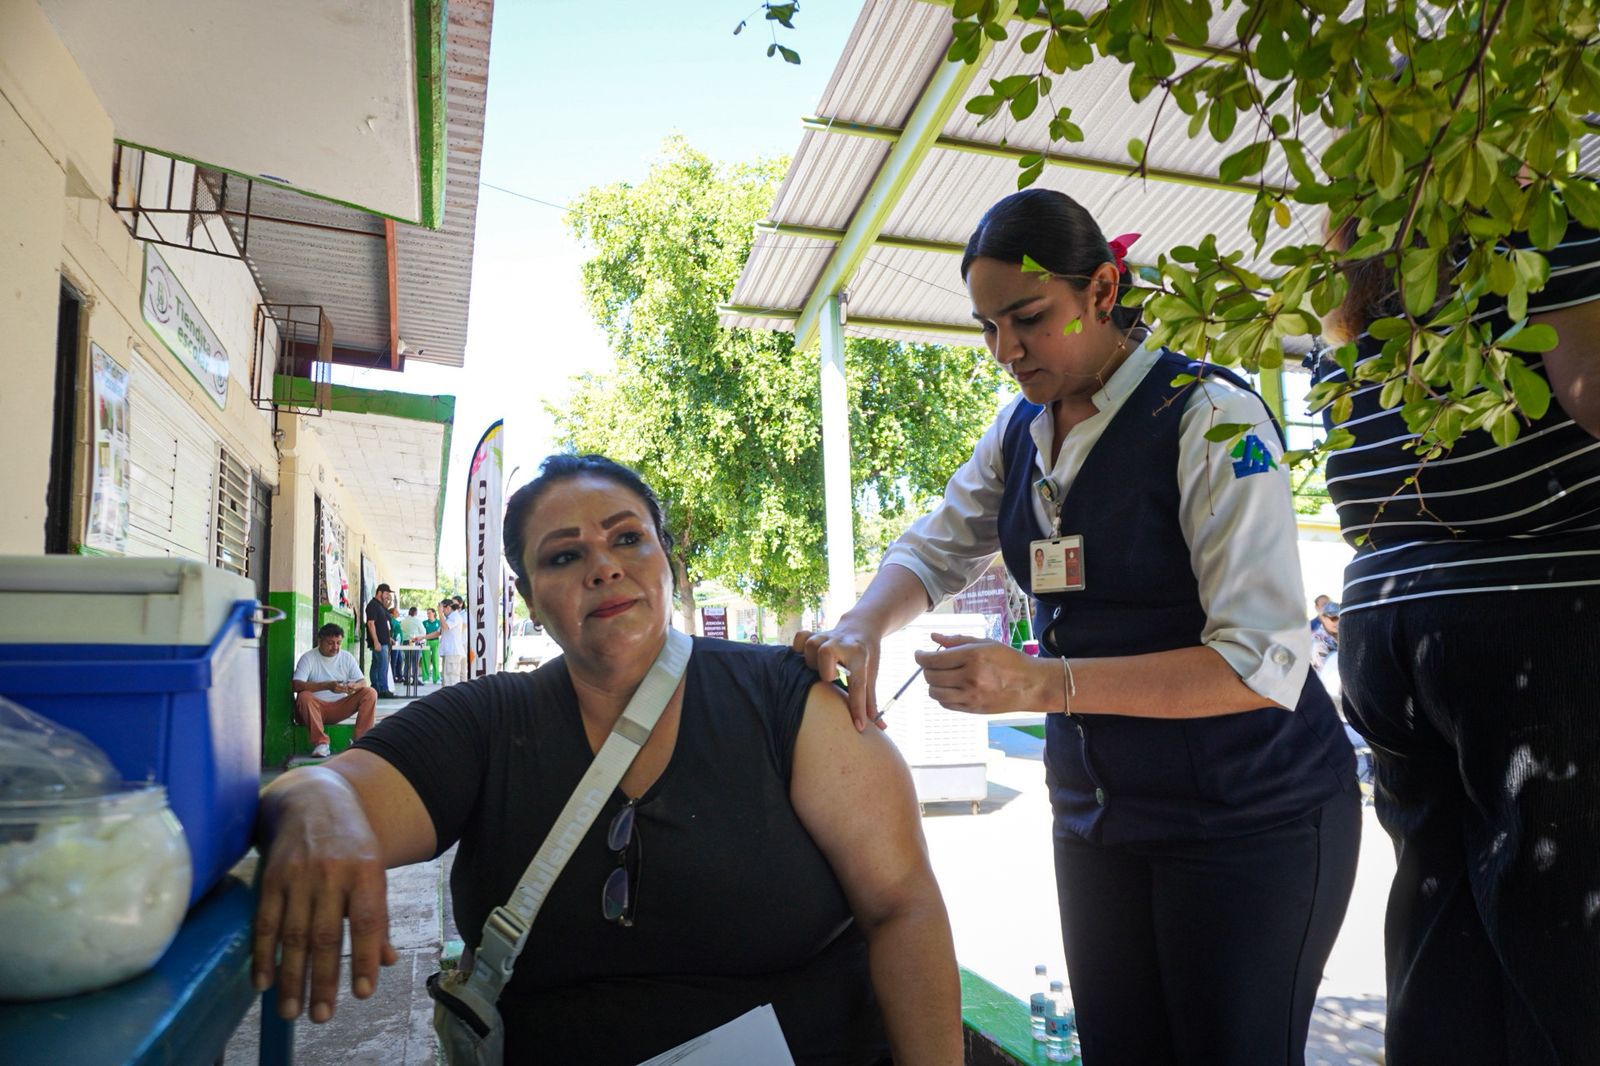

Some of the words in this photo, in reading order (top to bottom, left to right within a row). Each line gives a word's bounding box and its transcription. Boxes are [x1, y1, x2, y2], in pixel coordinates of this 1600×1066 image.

[175, 295, 211, 358] Tiendita
[177, 327, 208, 374] escolar
[475, 480, 487, 677] LOREANDO
[516, 788, 604, 919] ululemon
